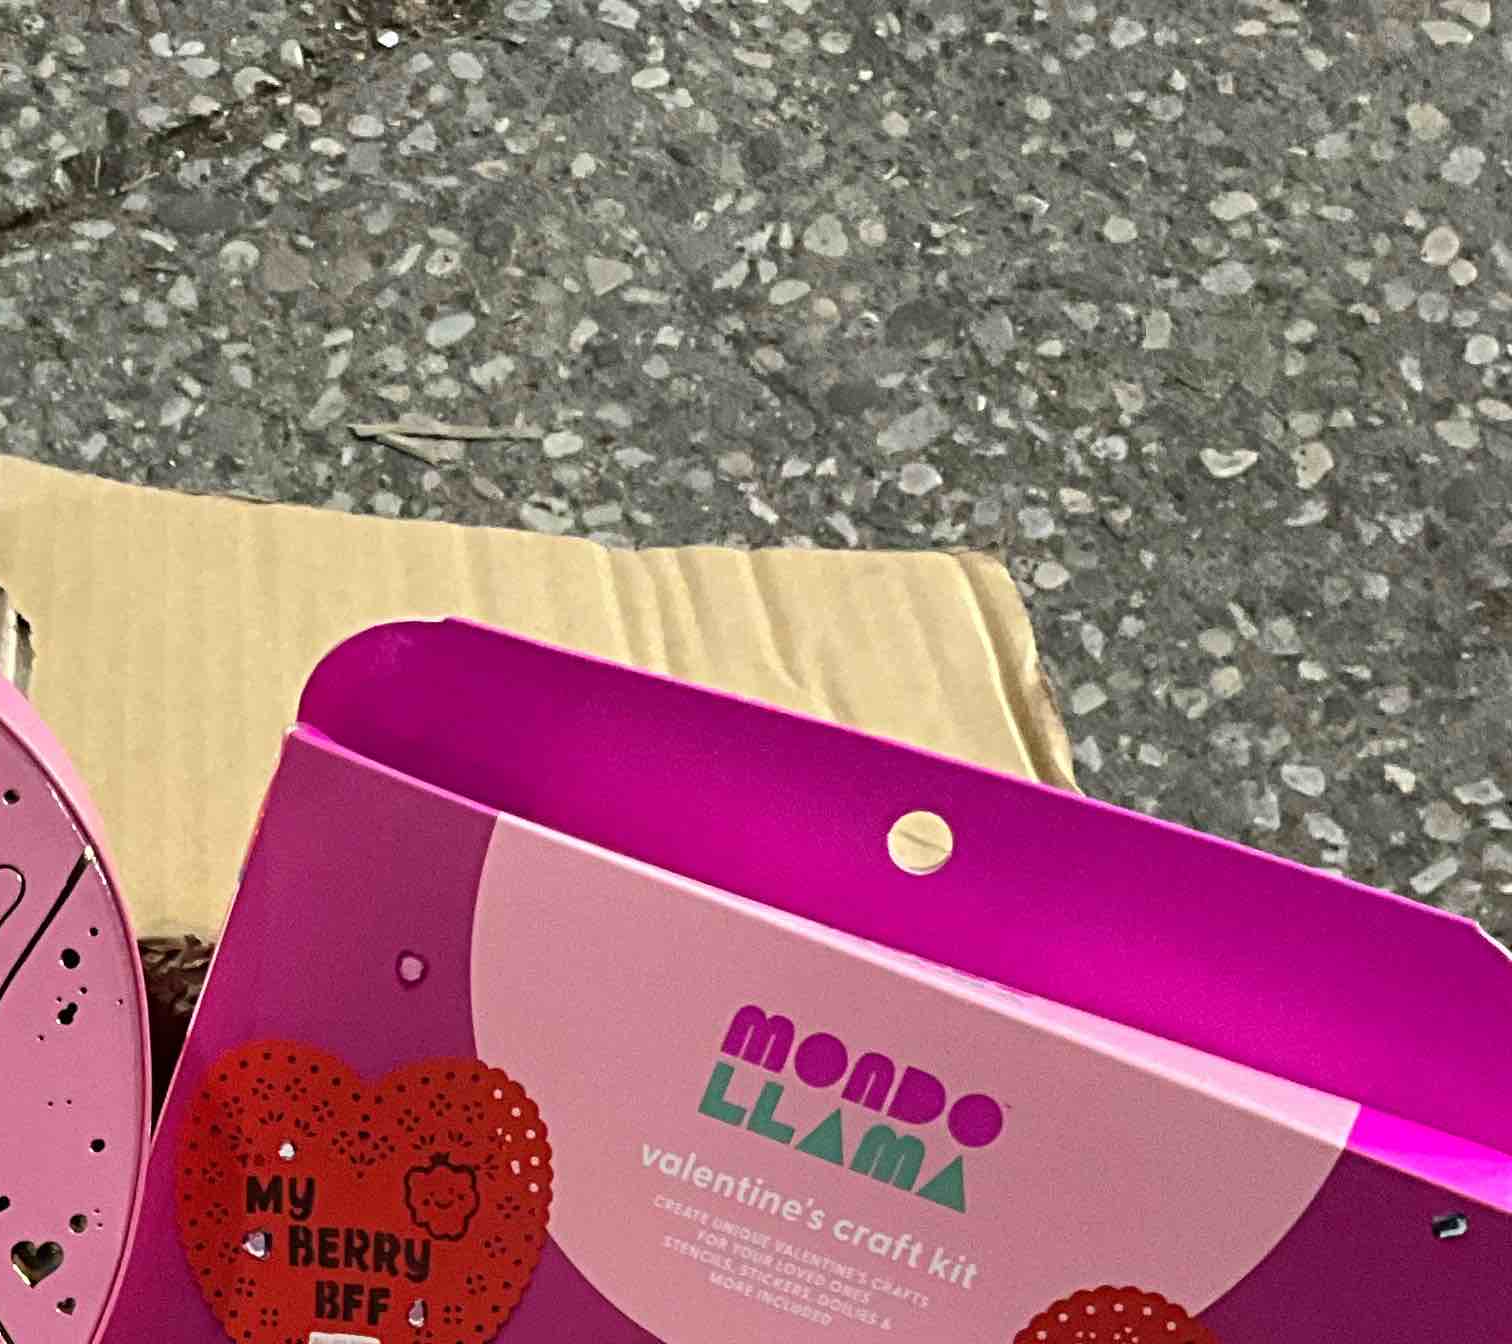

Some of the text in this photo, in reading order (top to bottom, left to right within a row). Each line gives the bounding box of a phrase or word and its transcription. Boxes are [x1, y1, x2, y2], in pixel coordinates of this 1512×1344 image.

[720, 1005, 1003, 1148] MONDO
[698, 1061, 967, 1213] LLAMA
[245, 1175, 316, 1221] MY
[642, 1143, 978, 1289] valentine's craft kit
[288, 1225, 432, 1283] BERRY
[653, 1194, 711, 1225] CREATE
[872, 1276, 929, 1308] CRAFTS
[696, 1230, 729, 1250] FOR
[733, 1243, 774, 1268] YOUR
[829, 1279, 872, 1305] ONES
[709, 1272, 753, 1297] MORE
[315, 1279, 392, 1325] BFF
